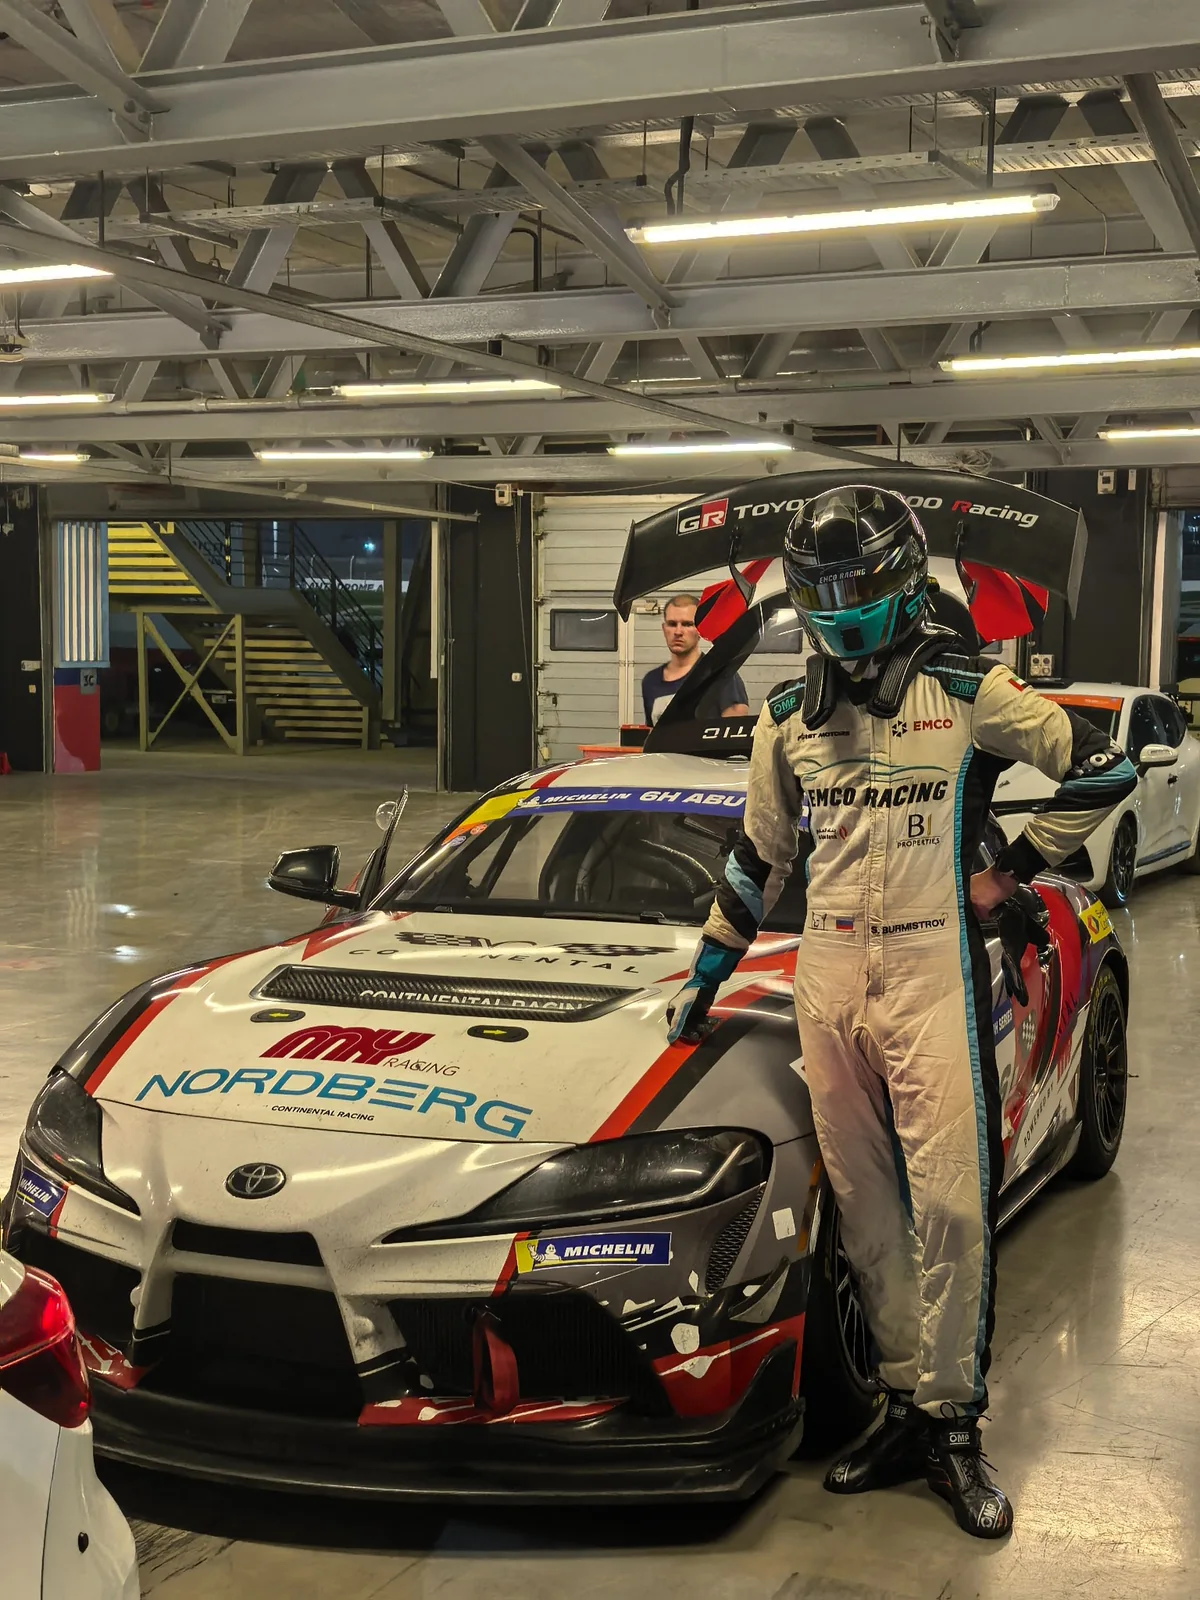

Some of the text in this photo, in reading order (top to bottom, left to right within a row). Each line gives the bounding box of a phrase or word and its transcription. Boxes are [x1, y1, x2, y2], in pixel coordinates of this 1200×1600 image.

[733, 497, 813, 520] TOYO
[951, 500, 1039, 529] Racing
[678, 511, 725, 534] GR
[819, 568, 866, 584] EMCO RACING
[946, 680, 978, 695] OMP
[773, 696, 797, 715] OMP
[913, 718, 954, 732] EMCO
[544, 790, 746, 808] MICHELIN 6H ABU
[808, 780, 949, 809] EMCO RACING
[897, 836, 941, 849] PROPERTIES
[870, 918, 946, 935] S. BURMISTROV
[382, 1057, 460, 1077] RACING
[134, 1068, 534, 1139] NORDBERG
[271, 1104, 375, 1121] CONTINENTAL RACING
[20, 1178, 53, 1204] MICHELIN
[564, 1243, 655, 1258] MICHELIN
[889, 1406, 907, 1416] OMP
[949, 1433, 970, 1443] OMP
[980, 1503, 998, 1529] OMP
